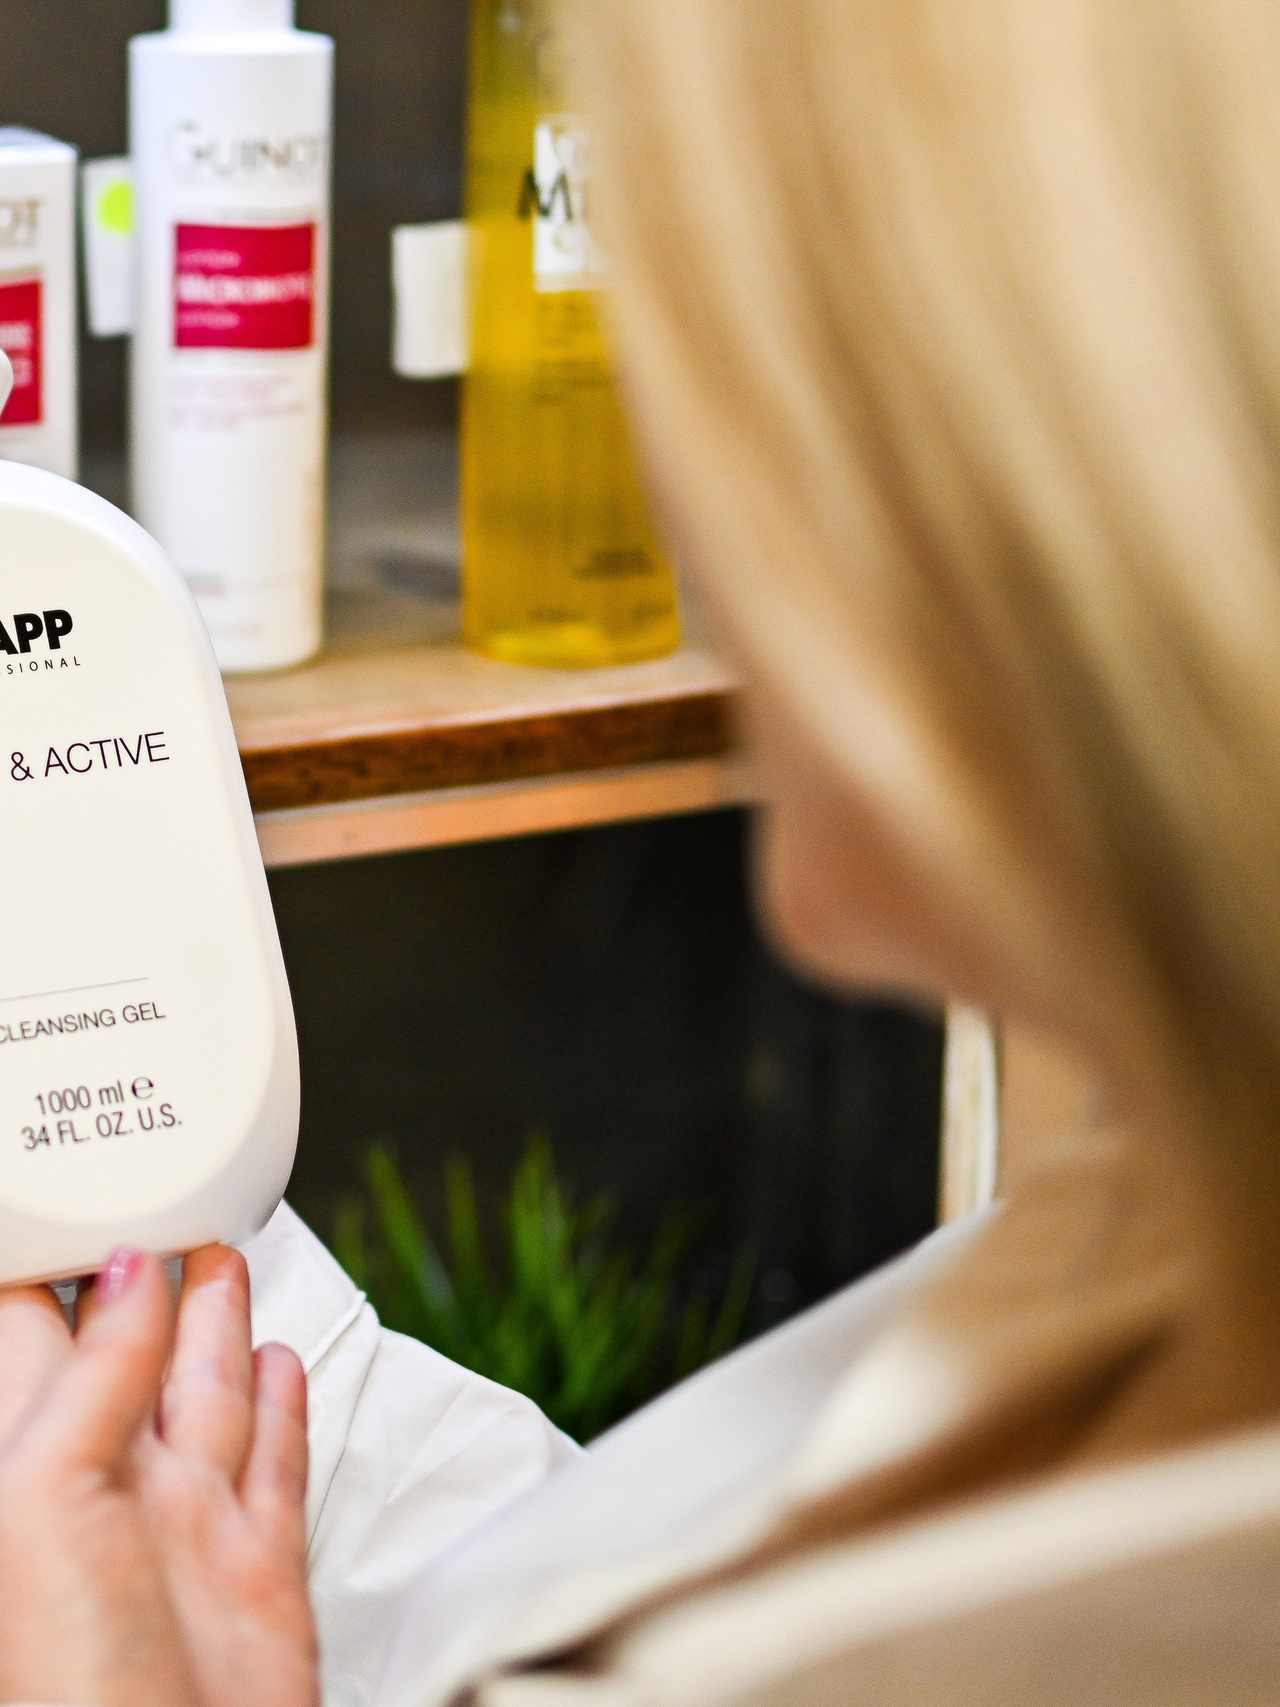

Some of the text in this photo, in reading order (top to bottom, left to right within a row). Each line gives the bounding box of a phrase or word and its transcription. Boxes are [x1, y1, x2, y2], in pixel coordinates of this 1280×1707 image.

[10, 751, 35, 781] &
[44, 731, 170, 778] ACTIVE
[123, 1002, 166, 1023] GEL
[35, 1085, 91, 1115] 1000
[98, 1080, 124, 1105] ml
[21, 1103, 183, 1151] 34 FL. OZ. U.S.
